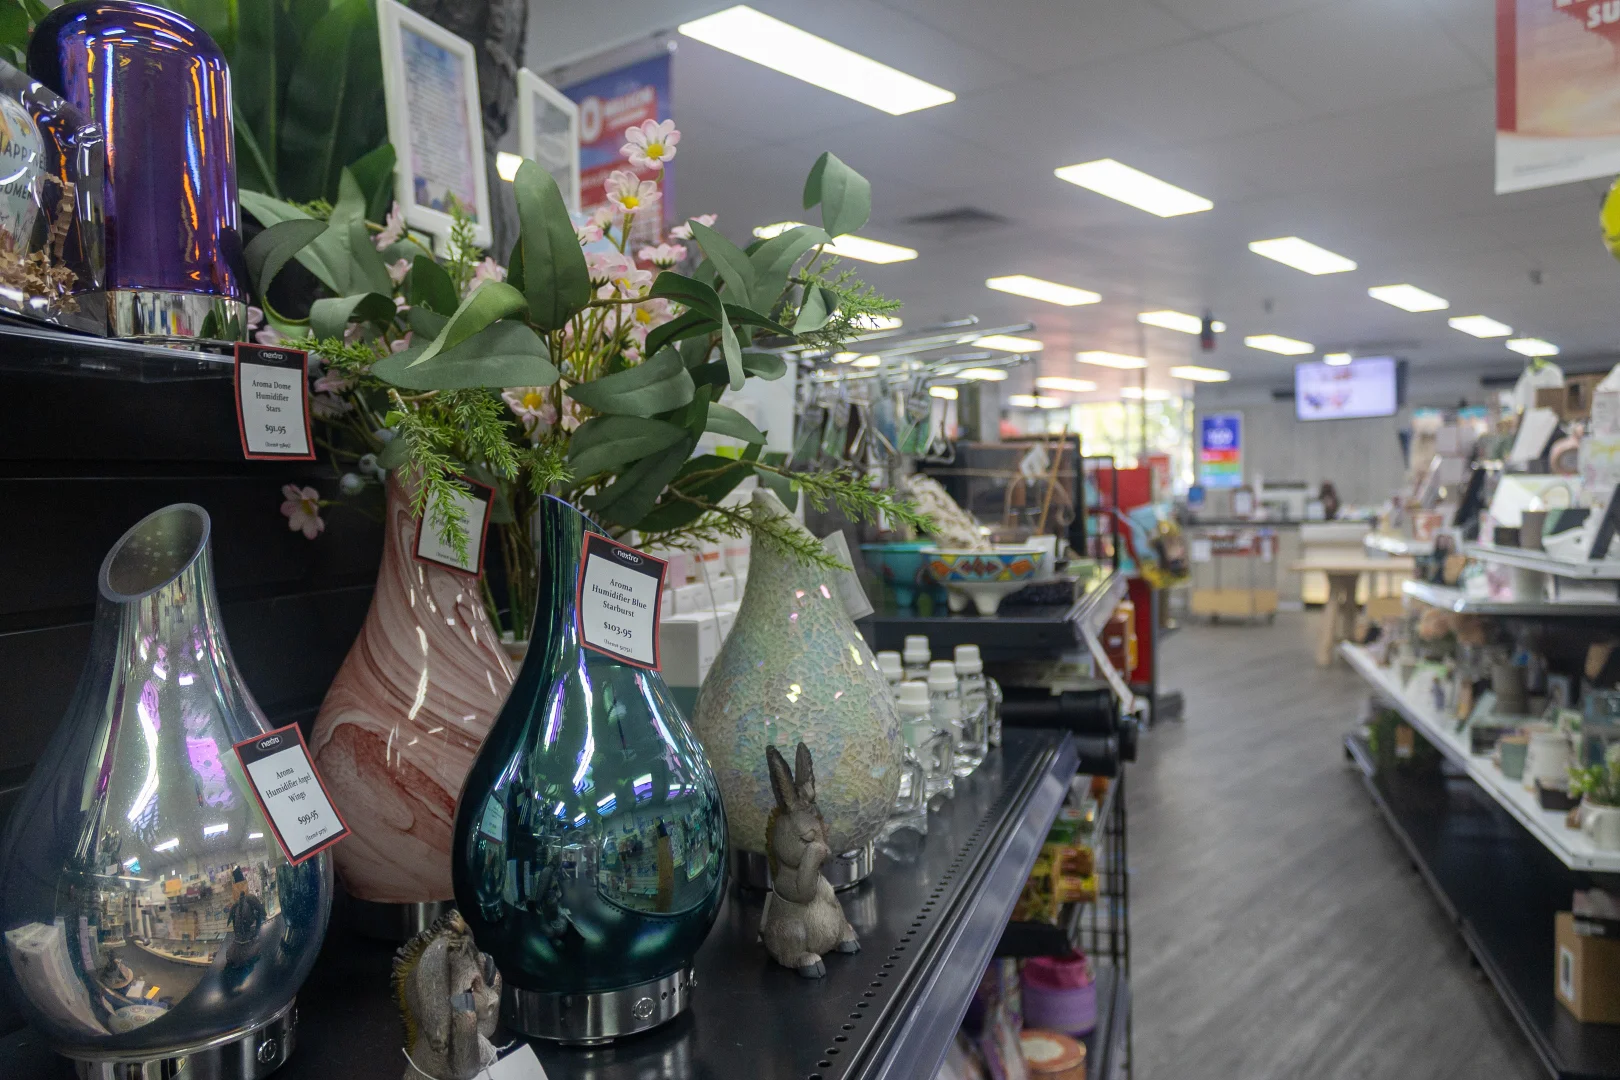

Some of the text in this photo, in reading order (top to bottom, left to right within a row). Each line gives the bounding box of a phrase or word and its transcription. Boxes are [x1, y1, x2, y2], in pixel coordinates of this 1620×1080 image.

[263, 351, 283, 360] nextra
[252, 380, 291, 390] Aroma Dome
[255, 391, 289, 402] Humidifier
[265, 404, 281, 413] Stars
[264, 424, 287, 435] $91.95
[617, 550, 639, 563] nextra
[610, 579, 633, 592] Aroma
[592, 583, 647, 610] Humidifier Blue
[602, 600, 635, 618] Starburst
[603, 621, 632, 639] $103.95
[260, 736, 280, 749] nextra
[275, 767, 295, 780] Aroma
[265, 773, 312, 799] Humidifier Angel
[288, 790, 307, 803] Wings
[297, 810, 319, 826] $99.95
